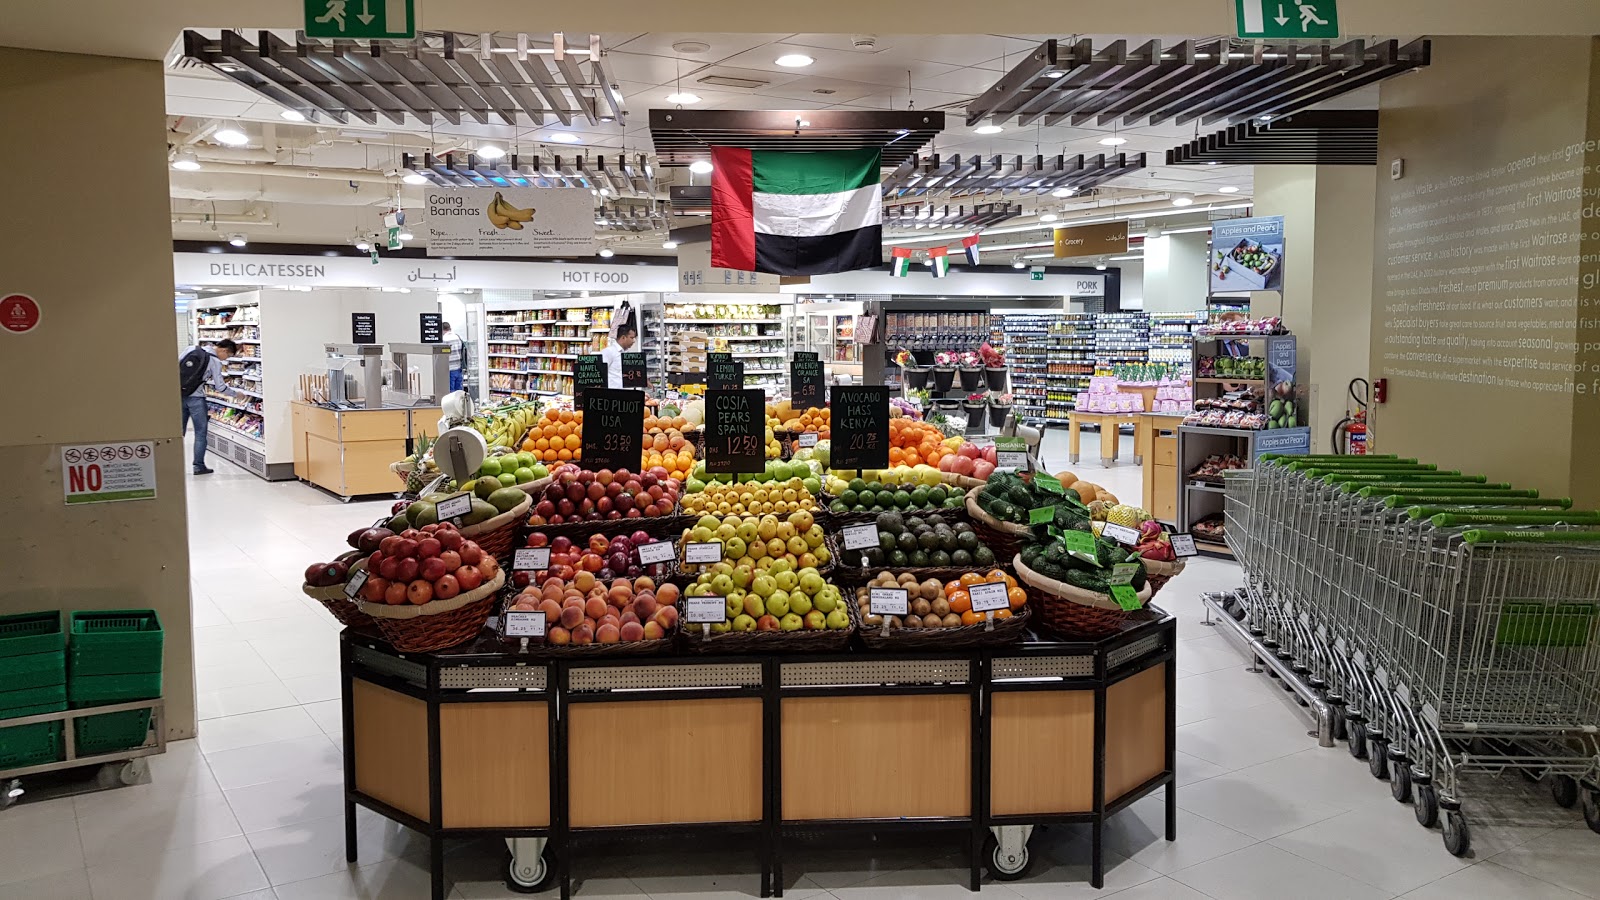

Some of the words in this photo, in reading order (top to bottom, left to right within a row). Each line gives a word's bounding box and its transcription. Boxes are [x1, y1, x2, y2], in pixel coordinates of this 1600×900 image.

[1449, 174, 1465, 187] Rose
[1507, 153, 1536, 173] opened
[1537, 174, 1551, 185] have
[1551, 168, 1575, 182] become
[1576, 165, 1591, 177] one
[430, 194, 463, 207] Going
[1495, 202, 1516, 215] opening
[1517, 200, 1526, 210] the
[1526, 194, 1542, 207] first
[1544, 187, 1581, 203] Waitrose
[430, 206, 480, 216] Bananas
[1221, 226, 1242, 236] Apples
[1243, 225, 1256, 233] and
[1257, 224, 1276, 232] Pears
[1476, 225, 1490, 236] Wales
[1490, 223, 1501, 234] and
[1515, 217, 1529, 230] 2008
[1529, 217, 1541, 228] two
[1547, 212, 1558, 225] the
[1065, 237, 1084, 246] Grocery
[1387, 254, 1411, 266] customer
[1450, 245, 1474, 259] history
[1499, 240, 1510, 251] with
[1510, 239, 1519, 249] the
[1519, 237, 1531, 249] first
[1532, 232, 1568, 246] Waitrose
[210, 263, 325, 277] DELICATESSEN
[1471, 262, 1484, 275] again
[1485, 260, 1495, 272] with
[1495, 260, 1505, 271] the
[1505, 257, 1520, 269] first
[1521, 254, 1557, 268] Waitrose
[1557, 254, 1572, 266] store
[408, 266, 457, 282] أجبان
[563, 271, 590, 282] HOT
[594, 272, 629, 284] FOOD
[1076, 281, 1098, 290] PORK
[1438, 280, 1465, 293] freshest,
[1477, 278, 1508, 294] premium
[1509, 278, 1533, 290] products
[1533, 276, 1546, 288] from
[1547, 274, 1568, 287] around
[1569, 274, 1579, 286] the
[1392, 301, 1410, 314] quality
[1418, 299, 1446, 312] freshness
[1482, 299, 1493, 310] what
[1494, 300, 1503, 310] our
[1504, 296, 1543, 308] customers
[1561, 297, 1573, 308] and
[1580, 296, 1590, 307] is
[1393, 317, 1418, 330] Specialist
[1418, 317, 1439, 332] buyers
[1449, 319, 1462, 331] great
[1462, 318, 1473, 329] care
[1479, 319, 1495, 329] source
[1495, 318, 1506, 329] fruit
[1506, 318, 1517, 329] and
[1517, 319, 1548, 331] vegetables,
[1549, 319, 1564, 329] meat
[1565, 318, 1577, 329] and
[1275, 343, 1292, 352] Apples
[1389, 334, 1421, 348] outstanding
[1421, 333, 1437, 347] taste
[1437, 337, 1446, 346] and
[1446, 334, 1470, 349] quality,
[1470, 337, 1486, 350] taking
[1496, 339, 1518, 349] account
[1518, 336, 1553, 349] seasonal
[1554, 341, 1580, 353] growing
[580, 364, 598, 372] NAVEL
[794, 362, 820, 370] VALENCIA
[1406, 351, 1442, 363] convenience
[1452, 355, 1482, 367] supermarket
[1482, 355, 1493, 367] with
[1493, 356, 1502, 367] the
[1503, 355, 1538, 371] expertise
[1539, 359, 1551, 371] and
[1551, 361, 1573, 373] service
[1573, 361, 1588, 373] of
[1591, 363, 1600, 373] a
[577, 371, 601, 379] ORANGE
[716, 364, 735, 374] LEMON
[797, 369, 820, 377] ORANGE
[714, 372, 738, 381] TURKEY
[1441, 371, 1458, 382] ultimate
[1458, 371, 1497, 384] destination
[1505, 377, 1520, 388] those
[1520, 379, 1532, 389] who
[1532, 381, 1563, 393] appreciate
[1564, 378, 1587, 393] fine
[716, 395, 750, 411] COSIA
[840, 391, 881, 404] AVOCADO
[589, 397, 610, 411] RED
[611, 399, 641, 414] PLUOT
[847, 404, 872, 416] HASS
[601, 414, 622, 428] USA
[718, 411, 751, 424] PEARS
[840, 417, 877, 430] KENYA
[717, 424, 749, 436] SPAIN
[1262, 439, 1279, 449] Apples
[1280, 437, 1290, 445] and
[68, 464, 103, 493] NO
[1418, 494, 1451, 502] Waitrose
[1470, 513, 1508, 523] Waitrose
[1504, 530, 1546, 539] Waitrose
